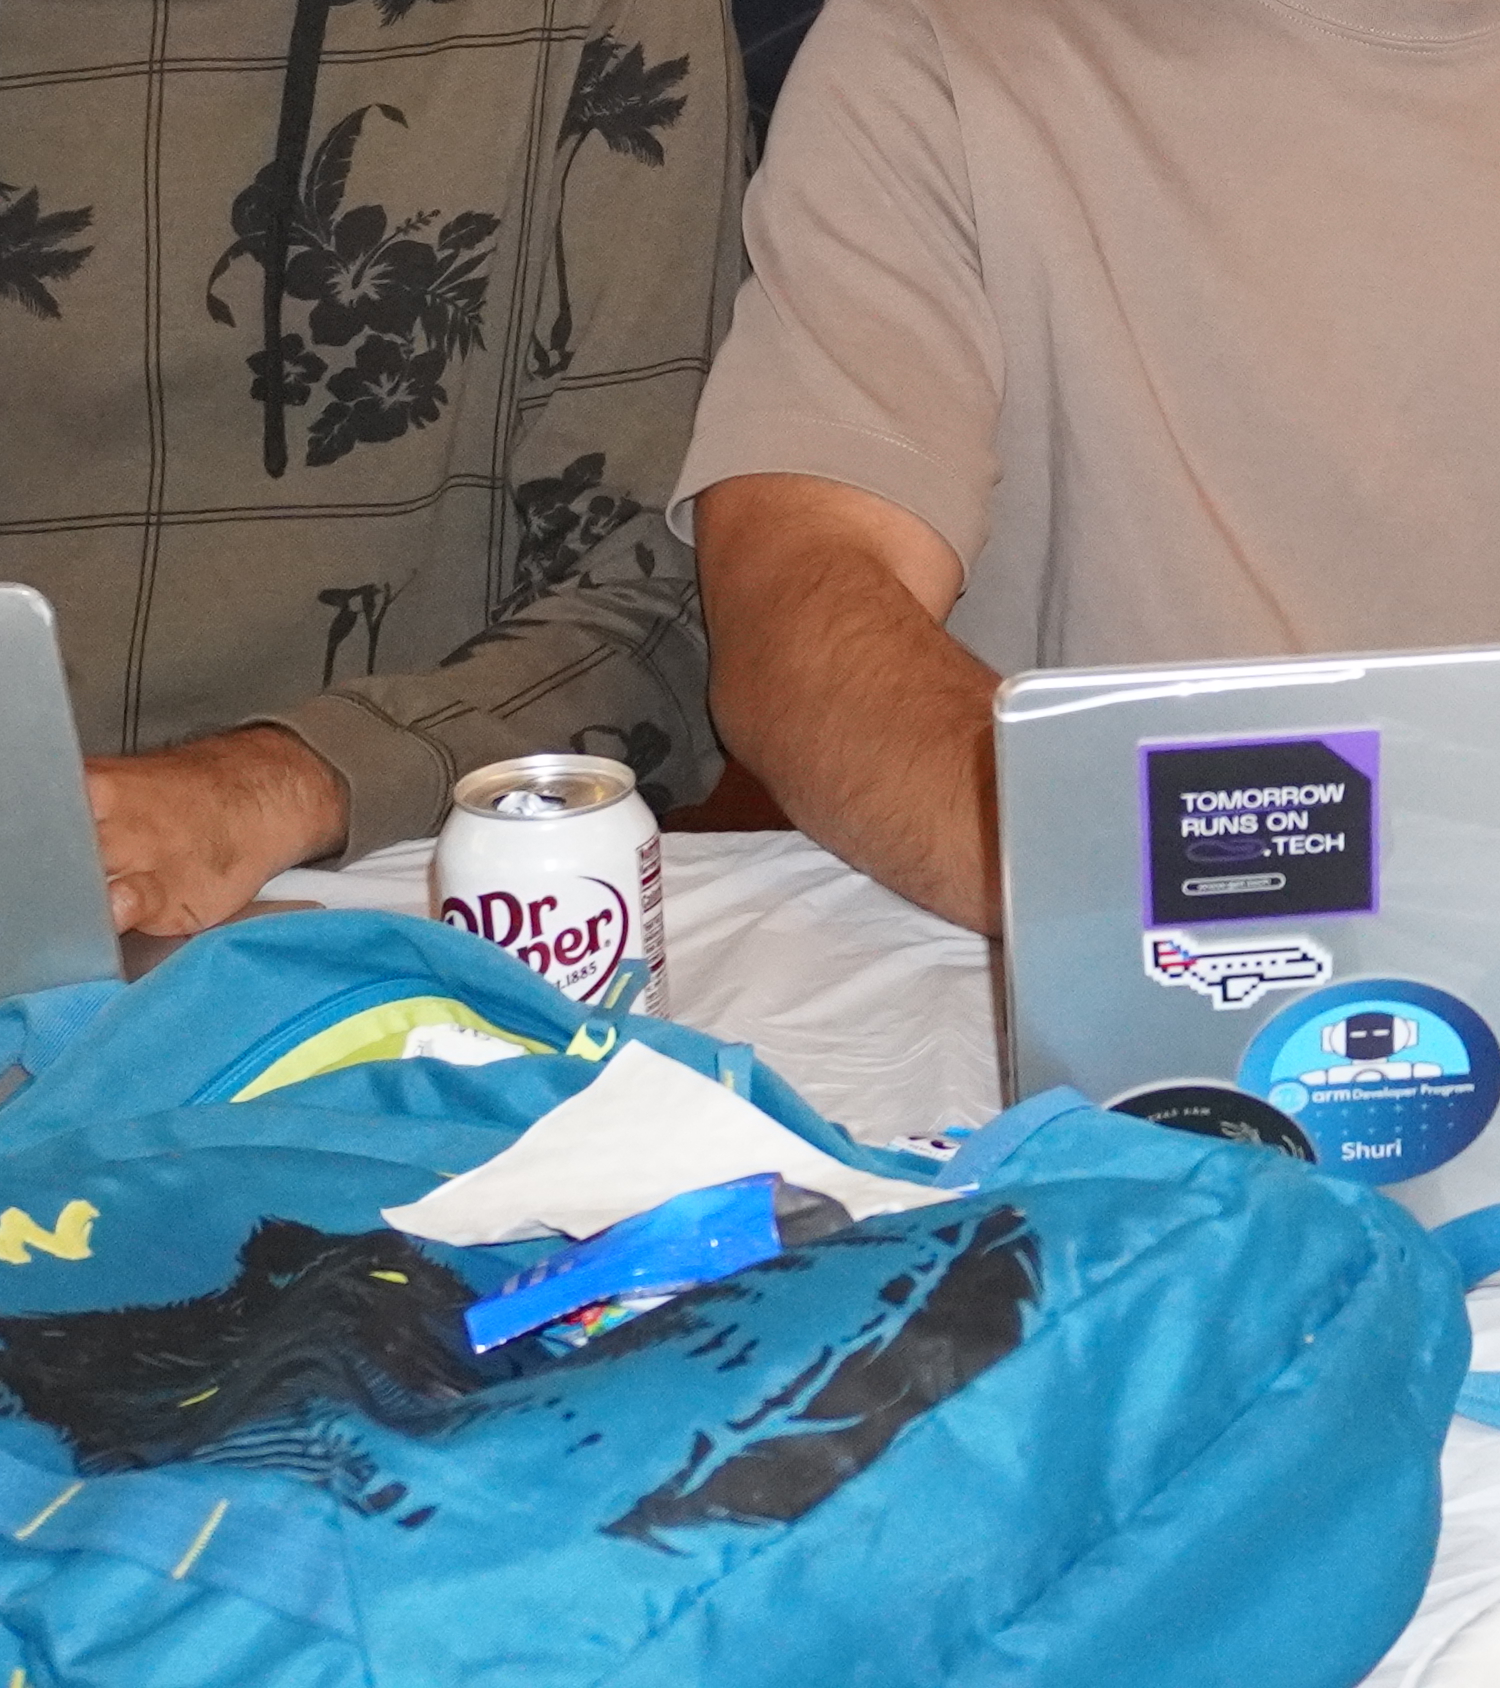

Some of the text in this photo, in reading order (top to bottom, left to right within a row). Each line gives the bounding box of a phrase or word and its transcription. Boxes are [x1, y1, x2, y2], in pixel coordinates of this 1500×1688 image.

[1181, 783, 1346, 813] TOMORROW
[1181, 811, 1309, 838] RUNS ON
[1263, 833, 1346, 858] .TECH
[477, 891, 558, 948] Dr
[565, 963, 597, 986] 1885
[1312, 1082, 1475, 1103] arm Developer Program
[1341, 1138, 1402, 1162] Shuri
